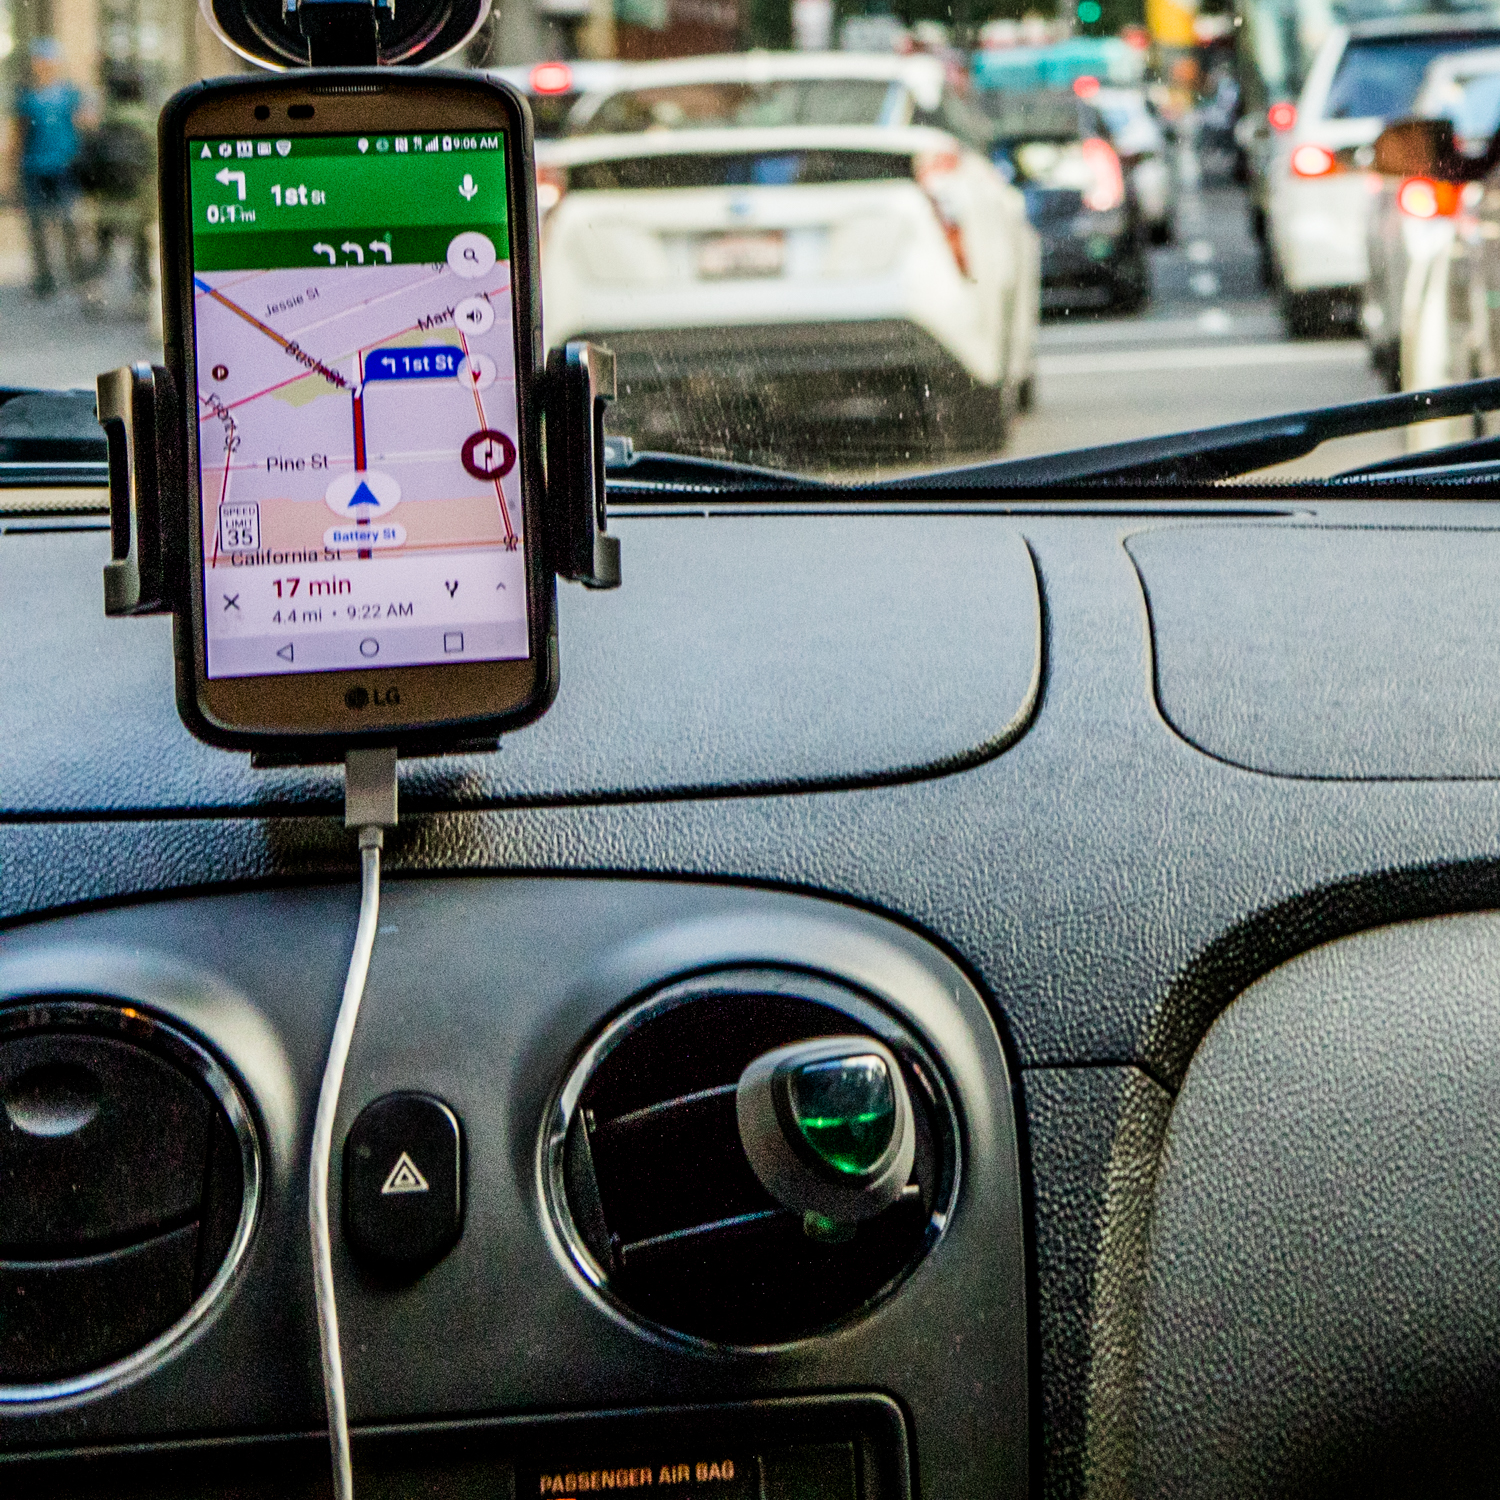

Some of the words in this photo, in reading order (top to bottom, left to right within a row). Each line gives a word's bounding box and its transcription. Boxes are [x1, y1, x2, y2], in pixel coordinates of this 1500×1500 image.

[453, 137, 477, 150] 9:06
[479, 135, 499, 150] AM
[271, 183, 308, 207] 1st
[311, 189, 326, 206] St
[265, 295, 304, 317] Jessie
[306, 287, 320, 301] St
[417, 305, 455, 332] Mark
[402, 356, 430, 373] 1st
[435, 353, 455, 372] St
[266, 455, 306, 473] Pine
[311, 453, 329, 471] St
[223, 507, 255, 516] SPEED
[225, 519, 252, 529] LIMIT
[228, 529, 253, 546] 35
[333, 528, 379, 543] Battery
[383, 528, 396, 541] St
[231, 546, 318, 567] California
[324, 546, 342, 562] St
[273, 577, 300, 598] 17
[309, 575, 351, 597] min
[273, 608, 297, 625] 4.4
[303, 607, 322, 623] mi
[347, 604, 381, 620] 9:22
[387, 602, 413, 618] AM
[374, 687, 401, 706] LG
[540, 1467, 653, 1496] PASSENGER
[658, 1463, 690, 1486] AIR
[695, 1459, 735, 1483] BAG
